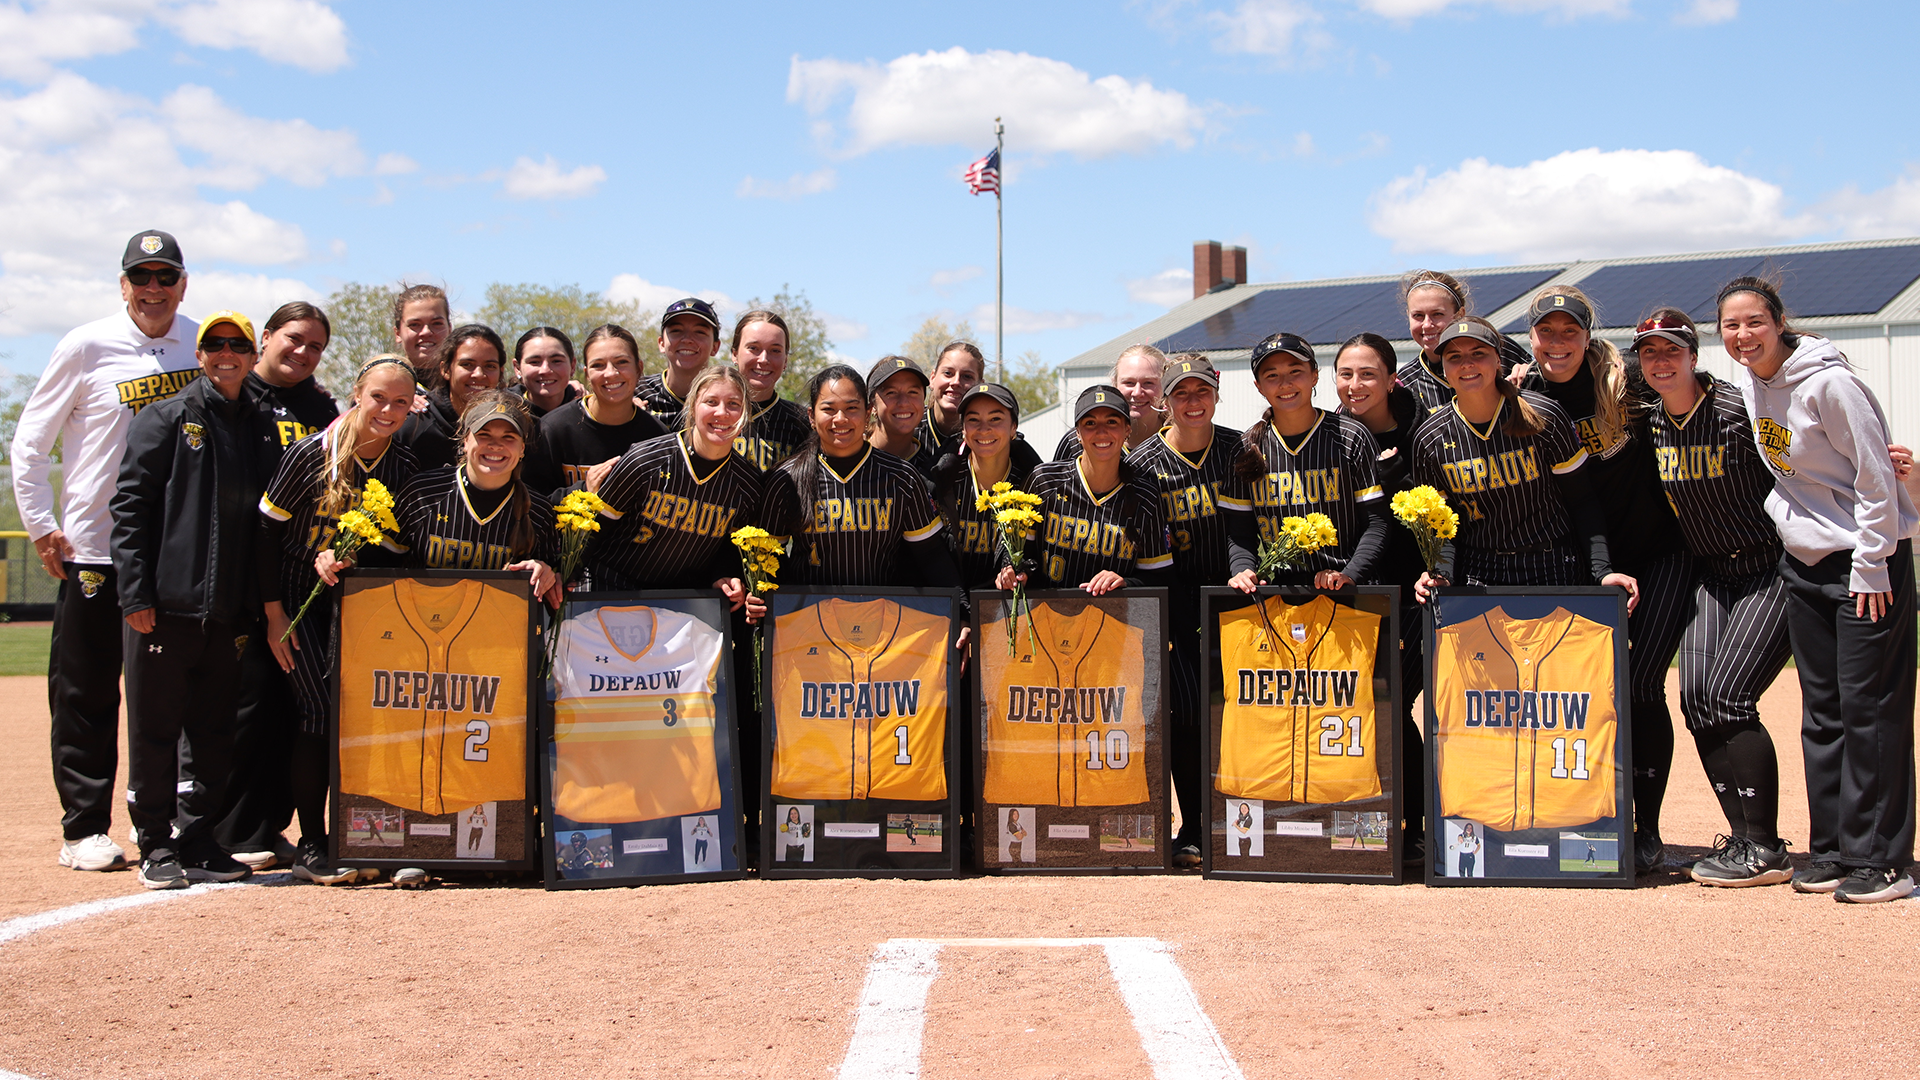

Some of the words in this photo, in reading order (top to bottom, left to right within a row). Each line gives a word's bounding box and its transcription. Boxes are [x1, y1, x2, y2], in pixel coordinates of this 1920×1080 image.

[1458, 323, 1469, 333] D
[1181, 362, 1192, 373] D
[1252, 467, 1340, 507] DEPAUW
[1442, 446, 1540, 494] DEPAUW
[633, 525, 654, 544] 3
[642, 491, 736, 538] DEPAUW
[803, 498, 893, 533] EPAUW
[1045, 511, 1140, 560] DEPAUW
[372, 669, 501, 715] DEPAUW
[589, 669, 682, 692] DEPAUW
[800, 679, 921, 720] DEPAUW
[1237, 669, 1359, 708] DEPAUW
[662, 698, 678, 727] 3
[1006, 685, 1126, 725] DEPAUW
[1464, 689, 1591, 732] DEPAUW
[463, 719, 490, 762] 2
[894, 725, 912, 765] 1
[1086, 729, 1130, 770] 10
[1319, 715, 1364, 757] 21
[1550, 737, 1590, 781] 11
